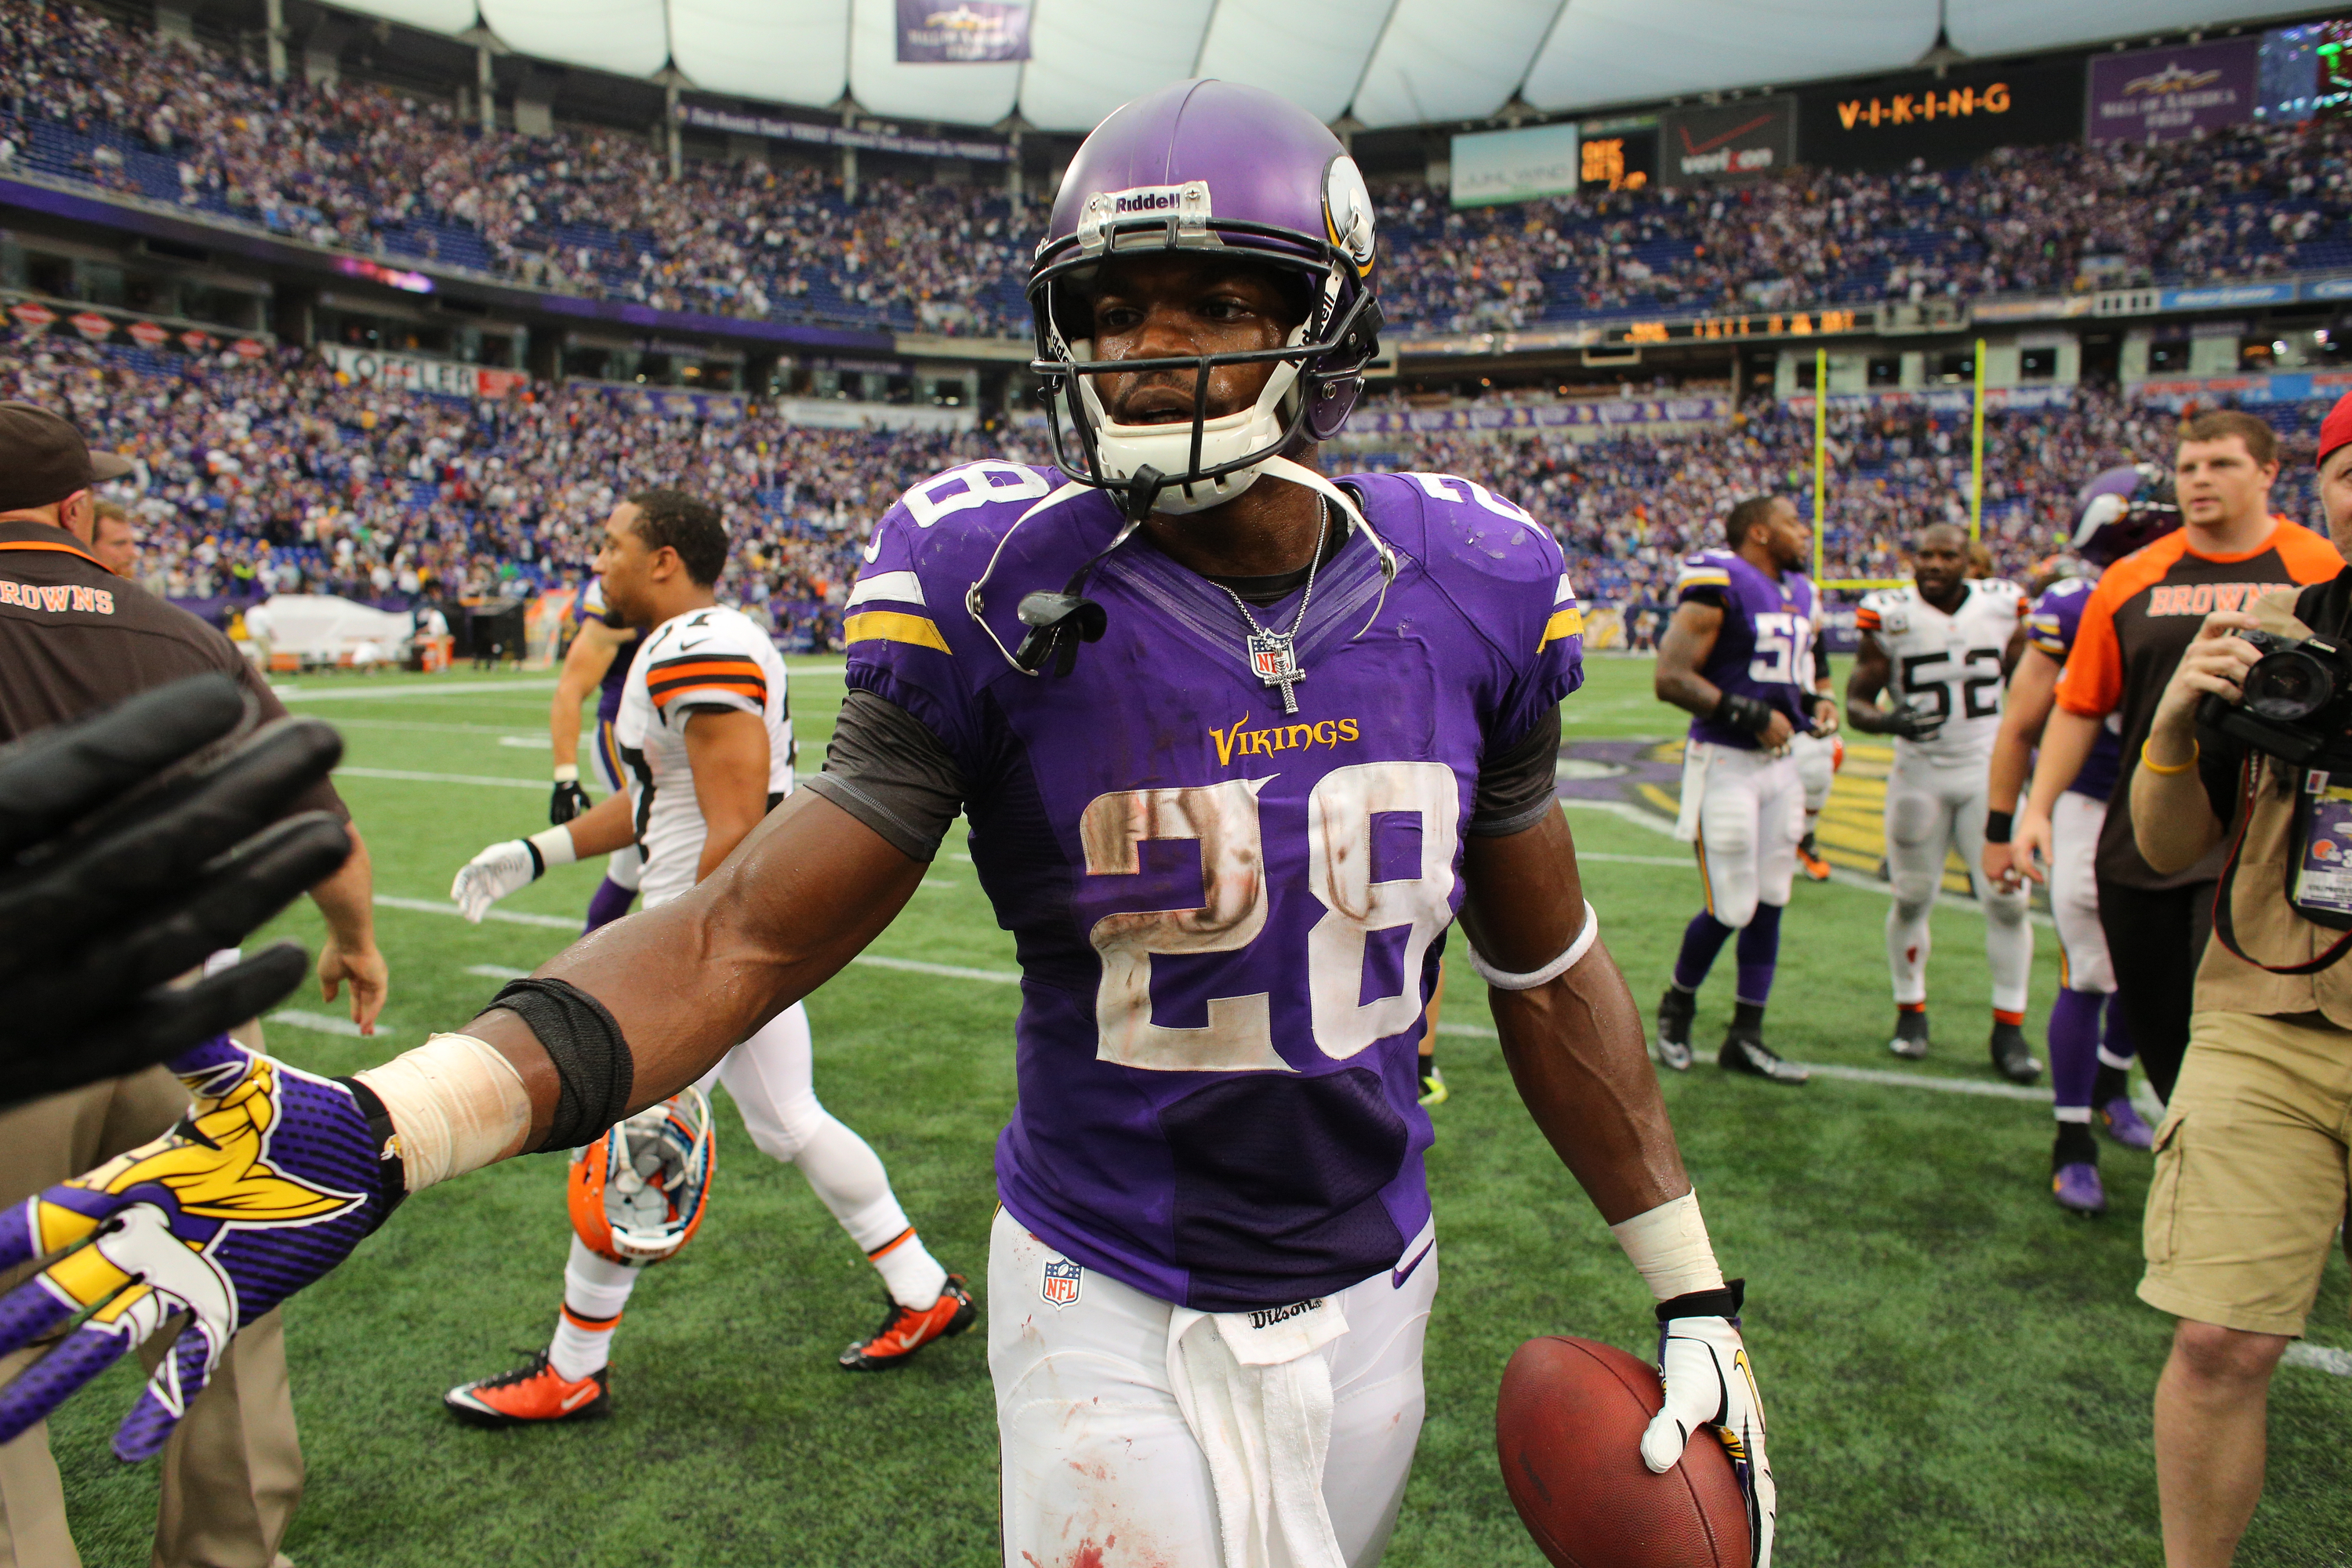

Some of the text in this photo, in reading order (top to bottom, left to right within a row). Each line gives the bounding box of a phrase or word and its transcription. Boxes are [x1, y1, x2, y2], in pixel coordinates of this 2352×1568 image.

[1837, 82, 2011, 131] V-I-K-I-N-G
[1680, 147, 1773, 175] verizon
[1116, 192, 1181, 214] Riddell
[0, 580, 115, 615] ROWNS
[2147, 583, 2294, 617] BROWN
[1900, 647, 2007, 742] 52
[1080, 760, 1461, 1074] 28
[1046, 1278, 1076, 1301] NFL
